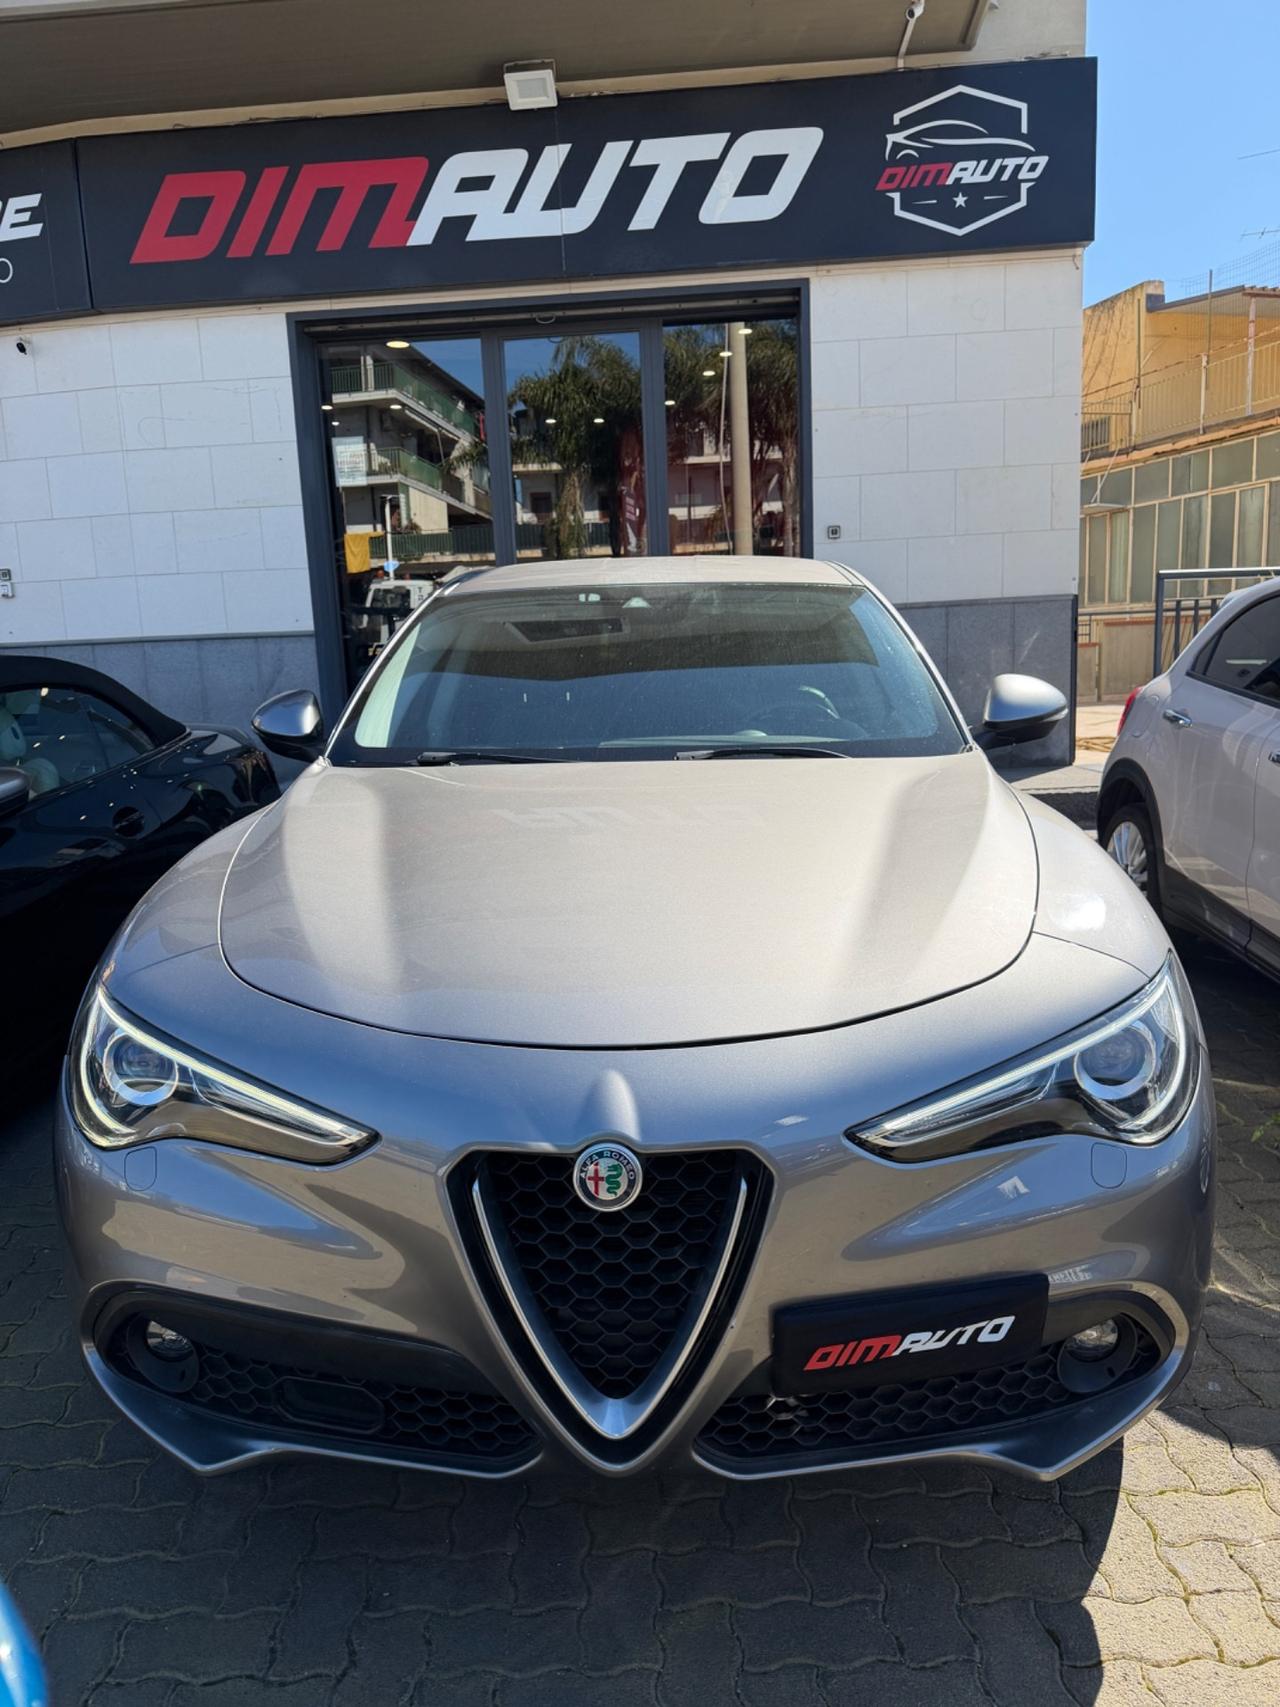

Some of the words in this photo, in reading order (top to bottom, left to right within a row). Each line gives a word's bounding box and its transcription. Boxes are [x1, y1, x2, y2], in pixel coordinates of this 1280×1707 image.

[131, 127, 824, 264] DIMAUTO
[875, 155, 1050, 191] DIMAUTO
[0, 193, 43, 242] E
[580, 1154, 599, 1179] ALFA
[603, 1151, 636, 1180] ROMEO
[803, 1315, 1016, 1371] DIMAUTO
